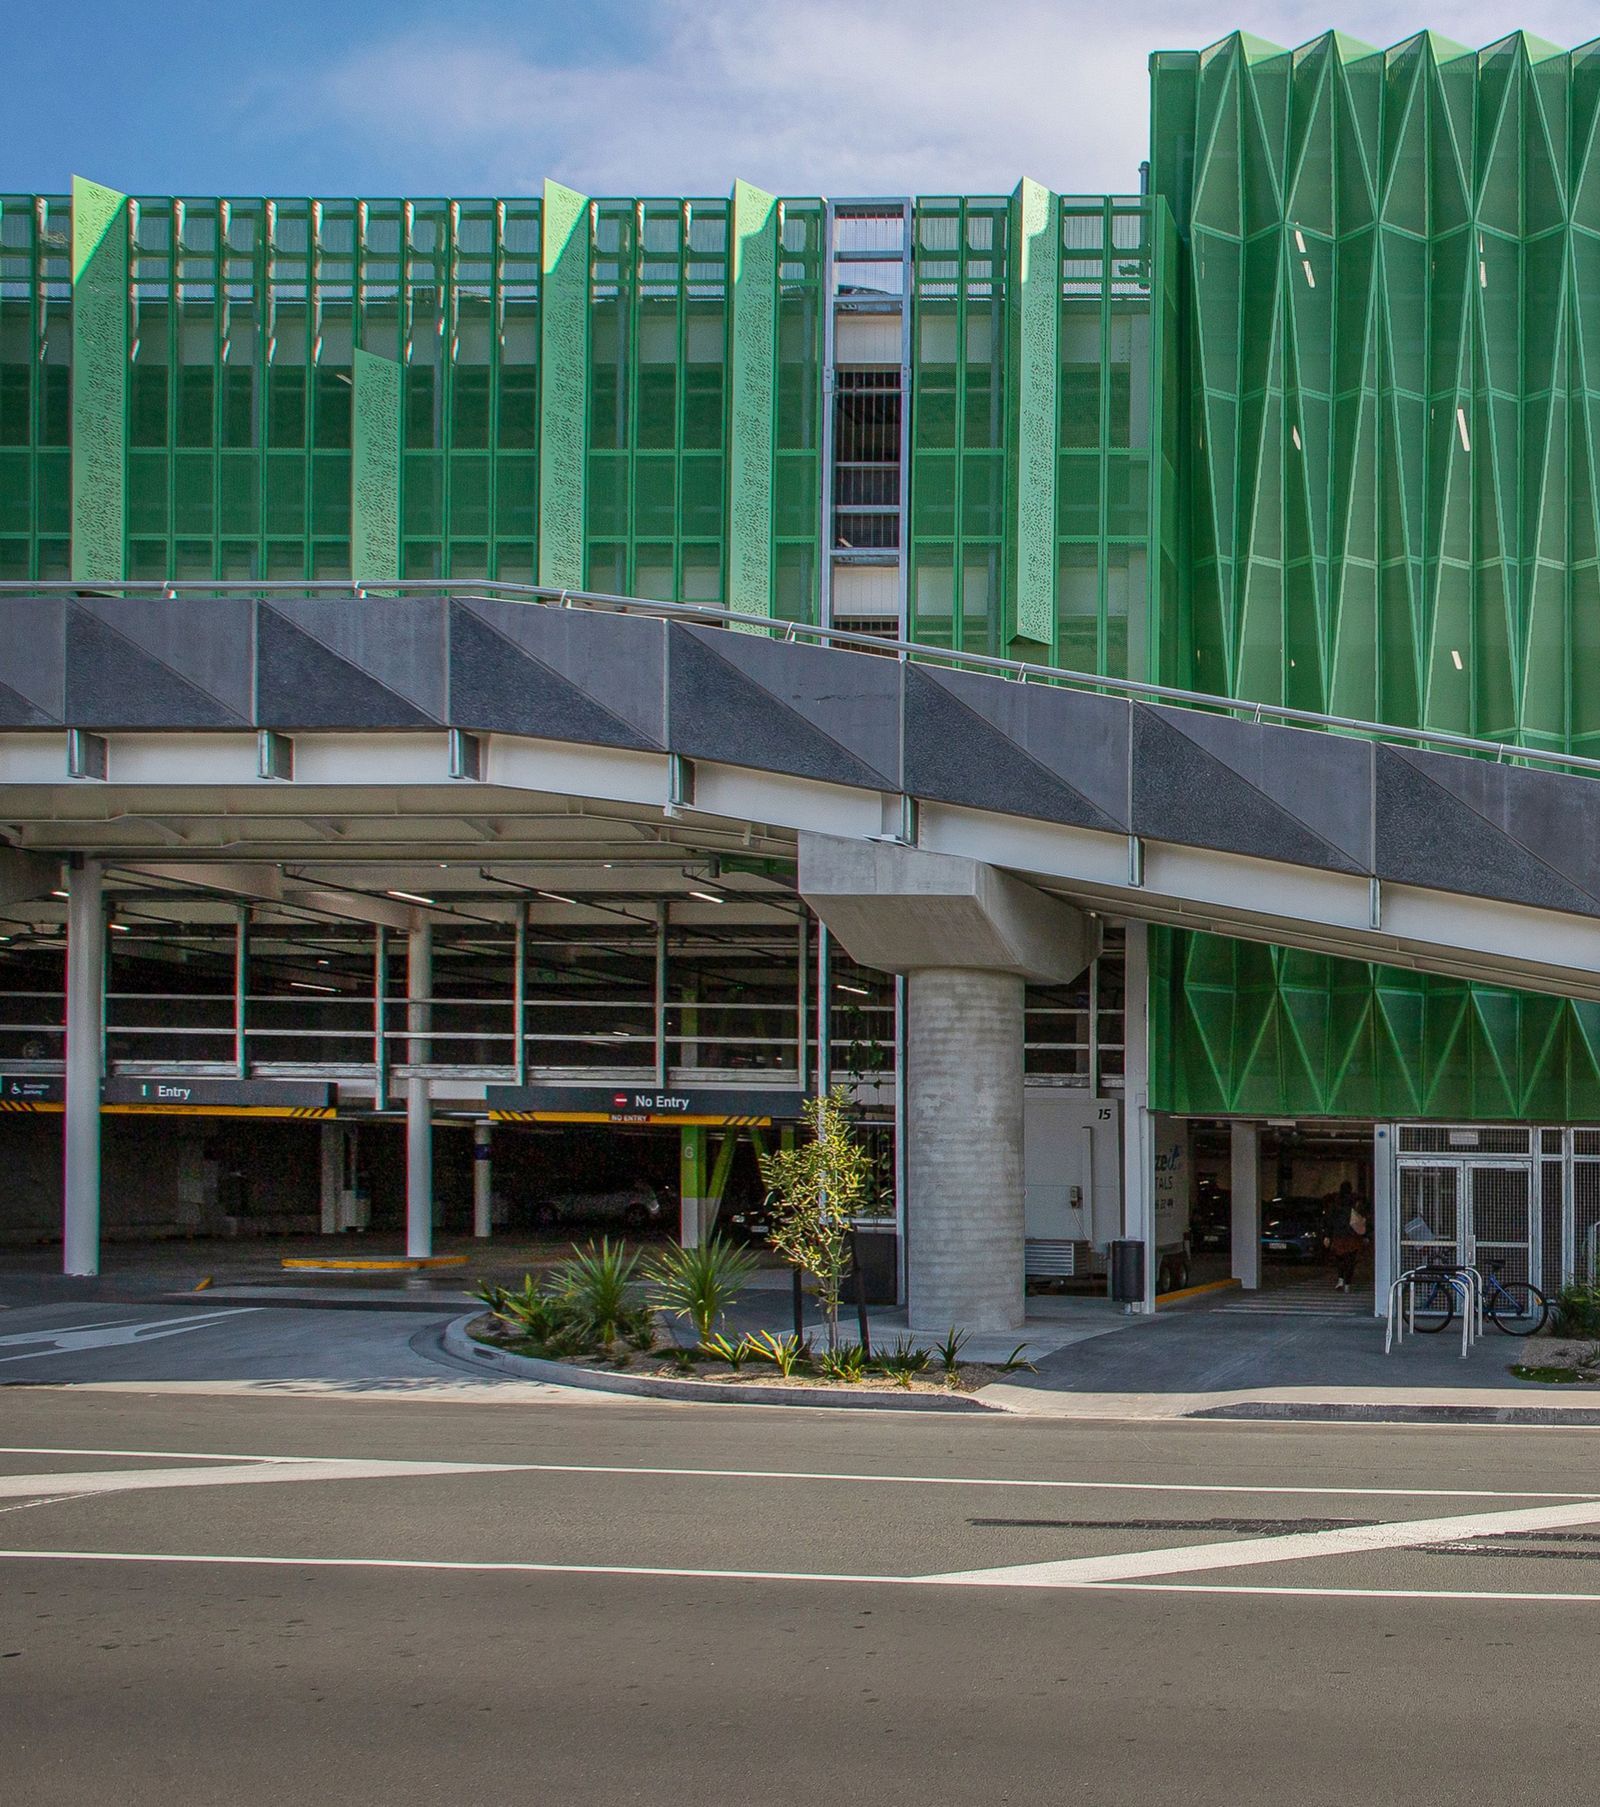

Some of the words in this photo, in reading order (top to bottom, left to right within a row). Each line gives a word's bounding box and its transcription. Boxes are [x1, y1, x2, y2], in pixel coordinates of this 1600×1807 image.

[157, 1085, 191, 1100] Entry
[635, 1095, 653, 1107] No
[656, 1096, 690, 1111] Entry
[624, 1114, 648, 1122] ENTRY
[1098, 1109, 1111, 1120] 15
